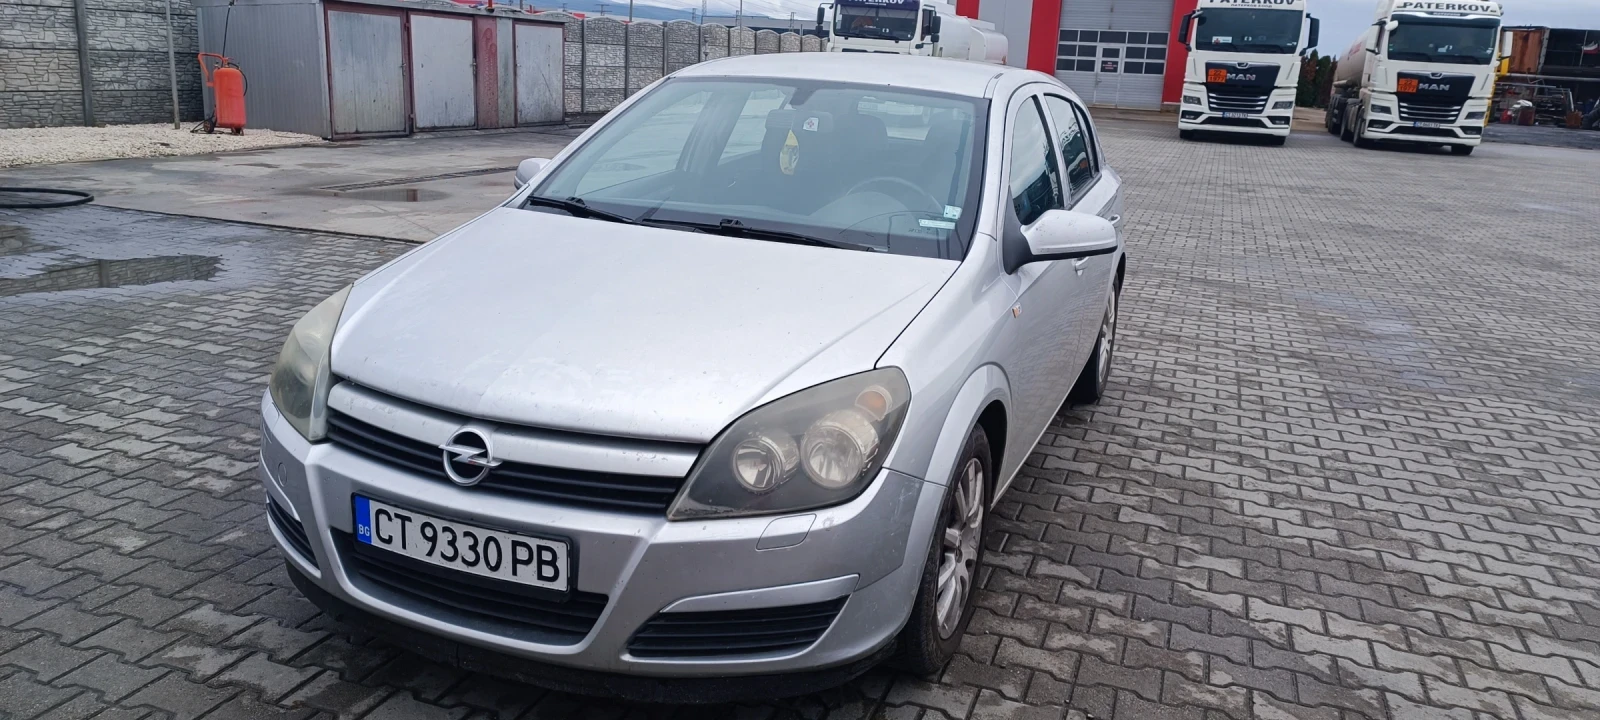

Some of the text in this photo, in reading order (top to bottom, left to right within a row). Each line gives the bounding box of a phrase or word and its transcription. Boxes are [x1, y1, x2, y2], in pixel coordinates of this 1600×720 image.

[1403, 2, 1491, 12] PATERKOV
[1226, 73, 1256, 81] MAN
[1418, 83, 1450, 91] MAN
[358, 524, 370, 537] BG
[374, 508, 560, 583] CT 9330 PB
